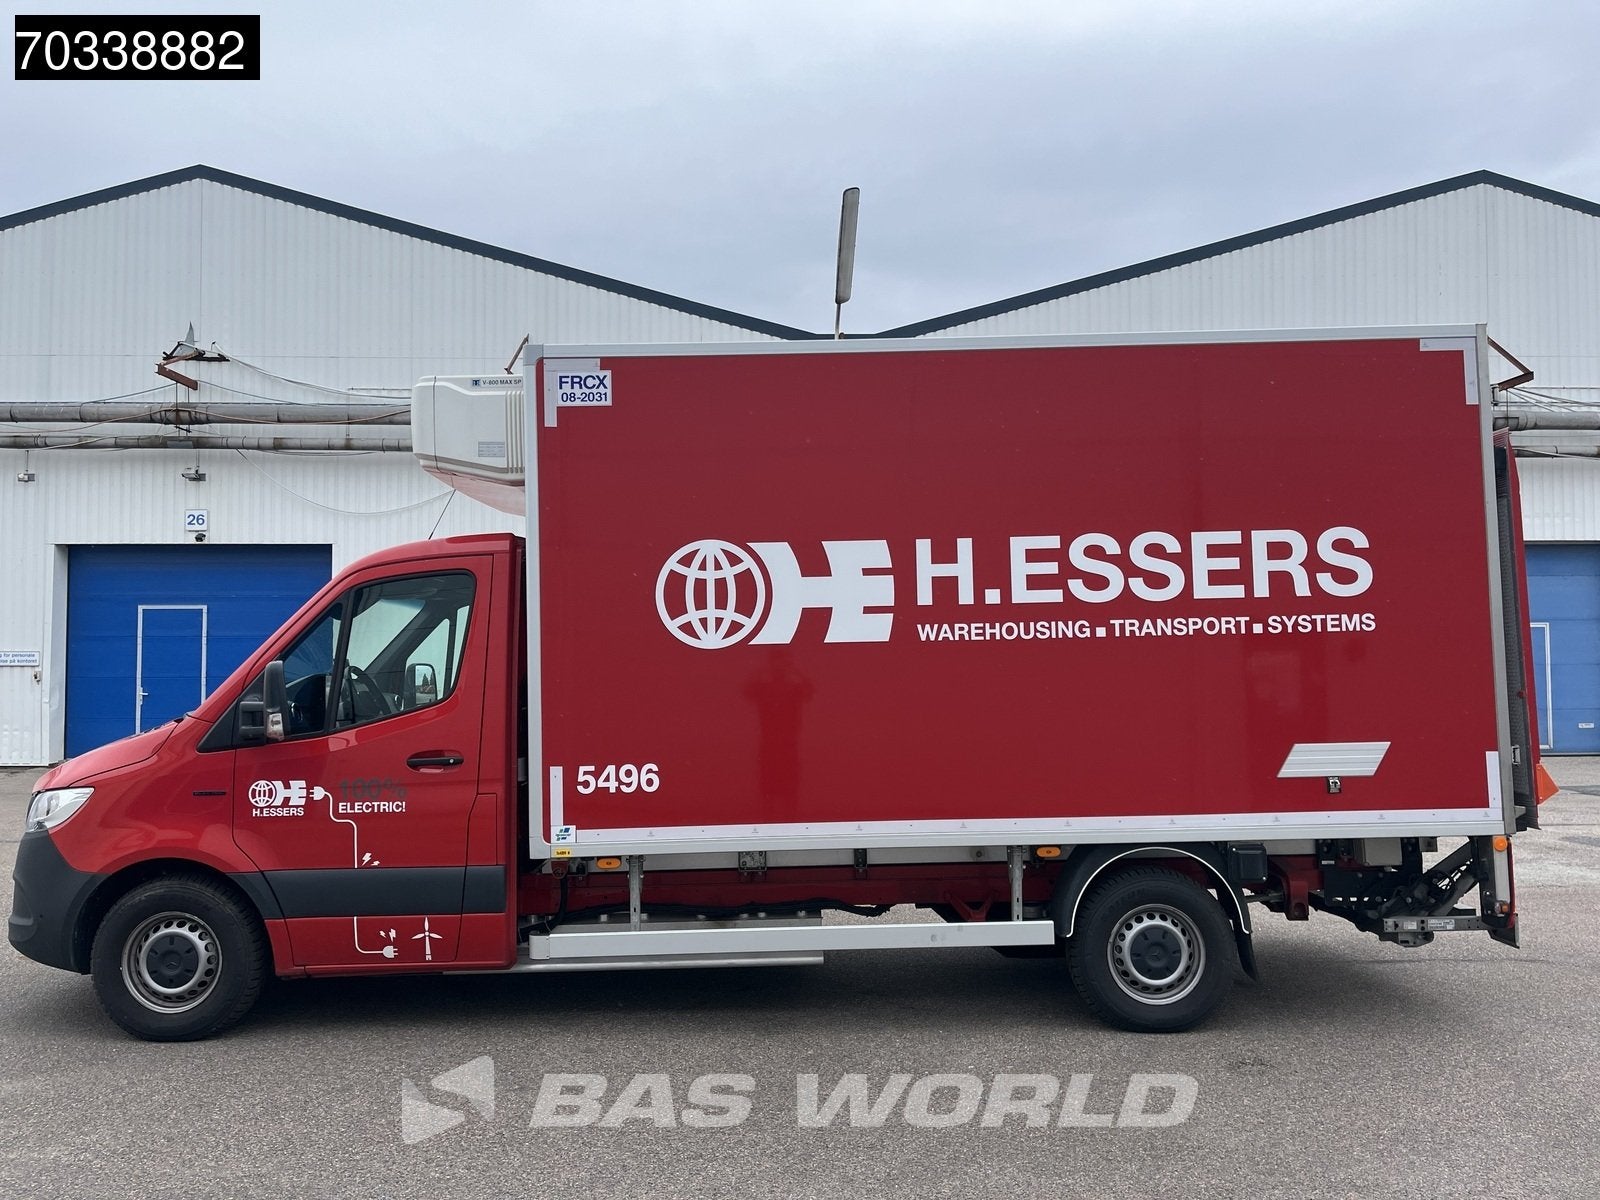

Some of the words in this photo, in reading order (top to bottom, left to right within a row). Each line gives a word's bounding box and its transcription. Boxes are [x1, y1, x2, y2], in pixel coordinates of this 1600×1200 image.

[558, 375, 608, 390] FRCX
[561, 391, 608, 403] 08-2031
[187, 514, 205, 526] 26
[914, 526, 1374, 606] H.ESSERS
[916, 620, 1091, 642] WAREHOUSING
[1109, 616, 1250, 638] TRANSPORT
[1267, 613, 1377, 634] SYSTEMS
[576, 763, 660, 795] 5496
[340, 776, 408, 801] 100%
[252, 807, 305, 817] H.ESSERS
[338, 801, 406, 814] ELECTRIC!
